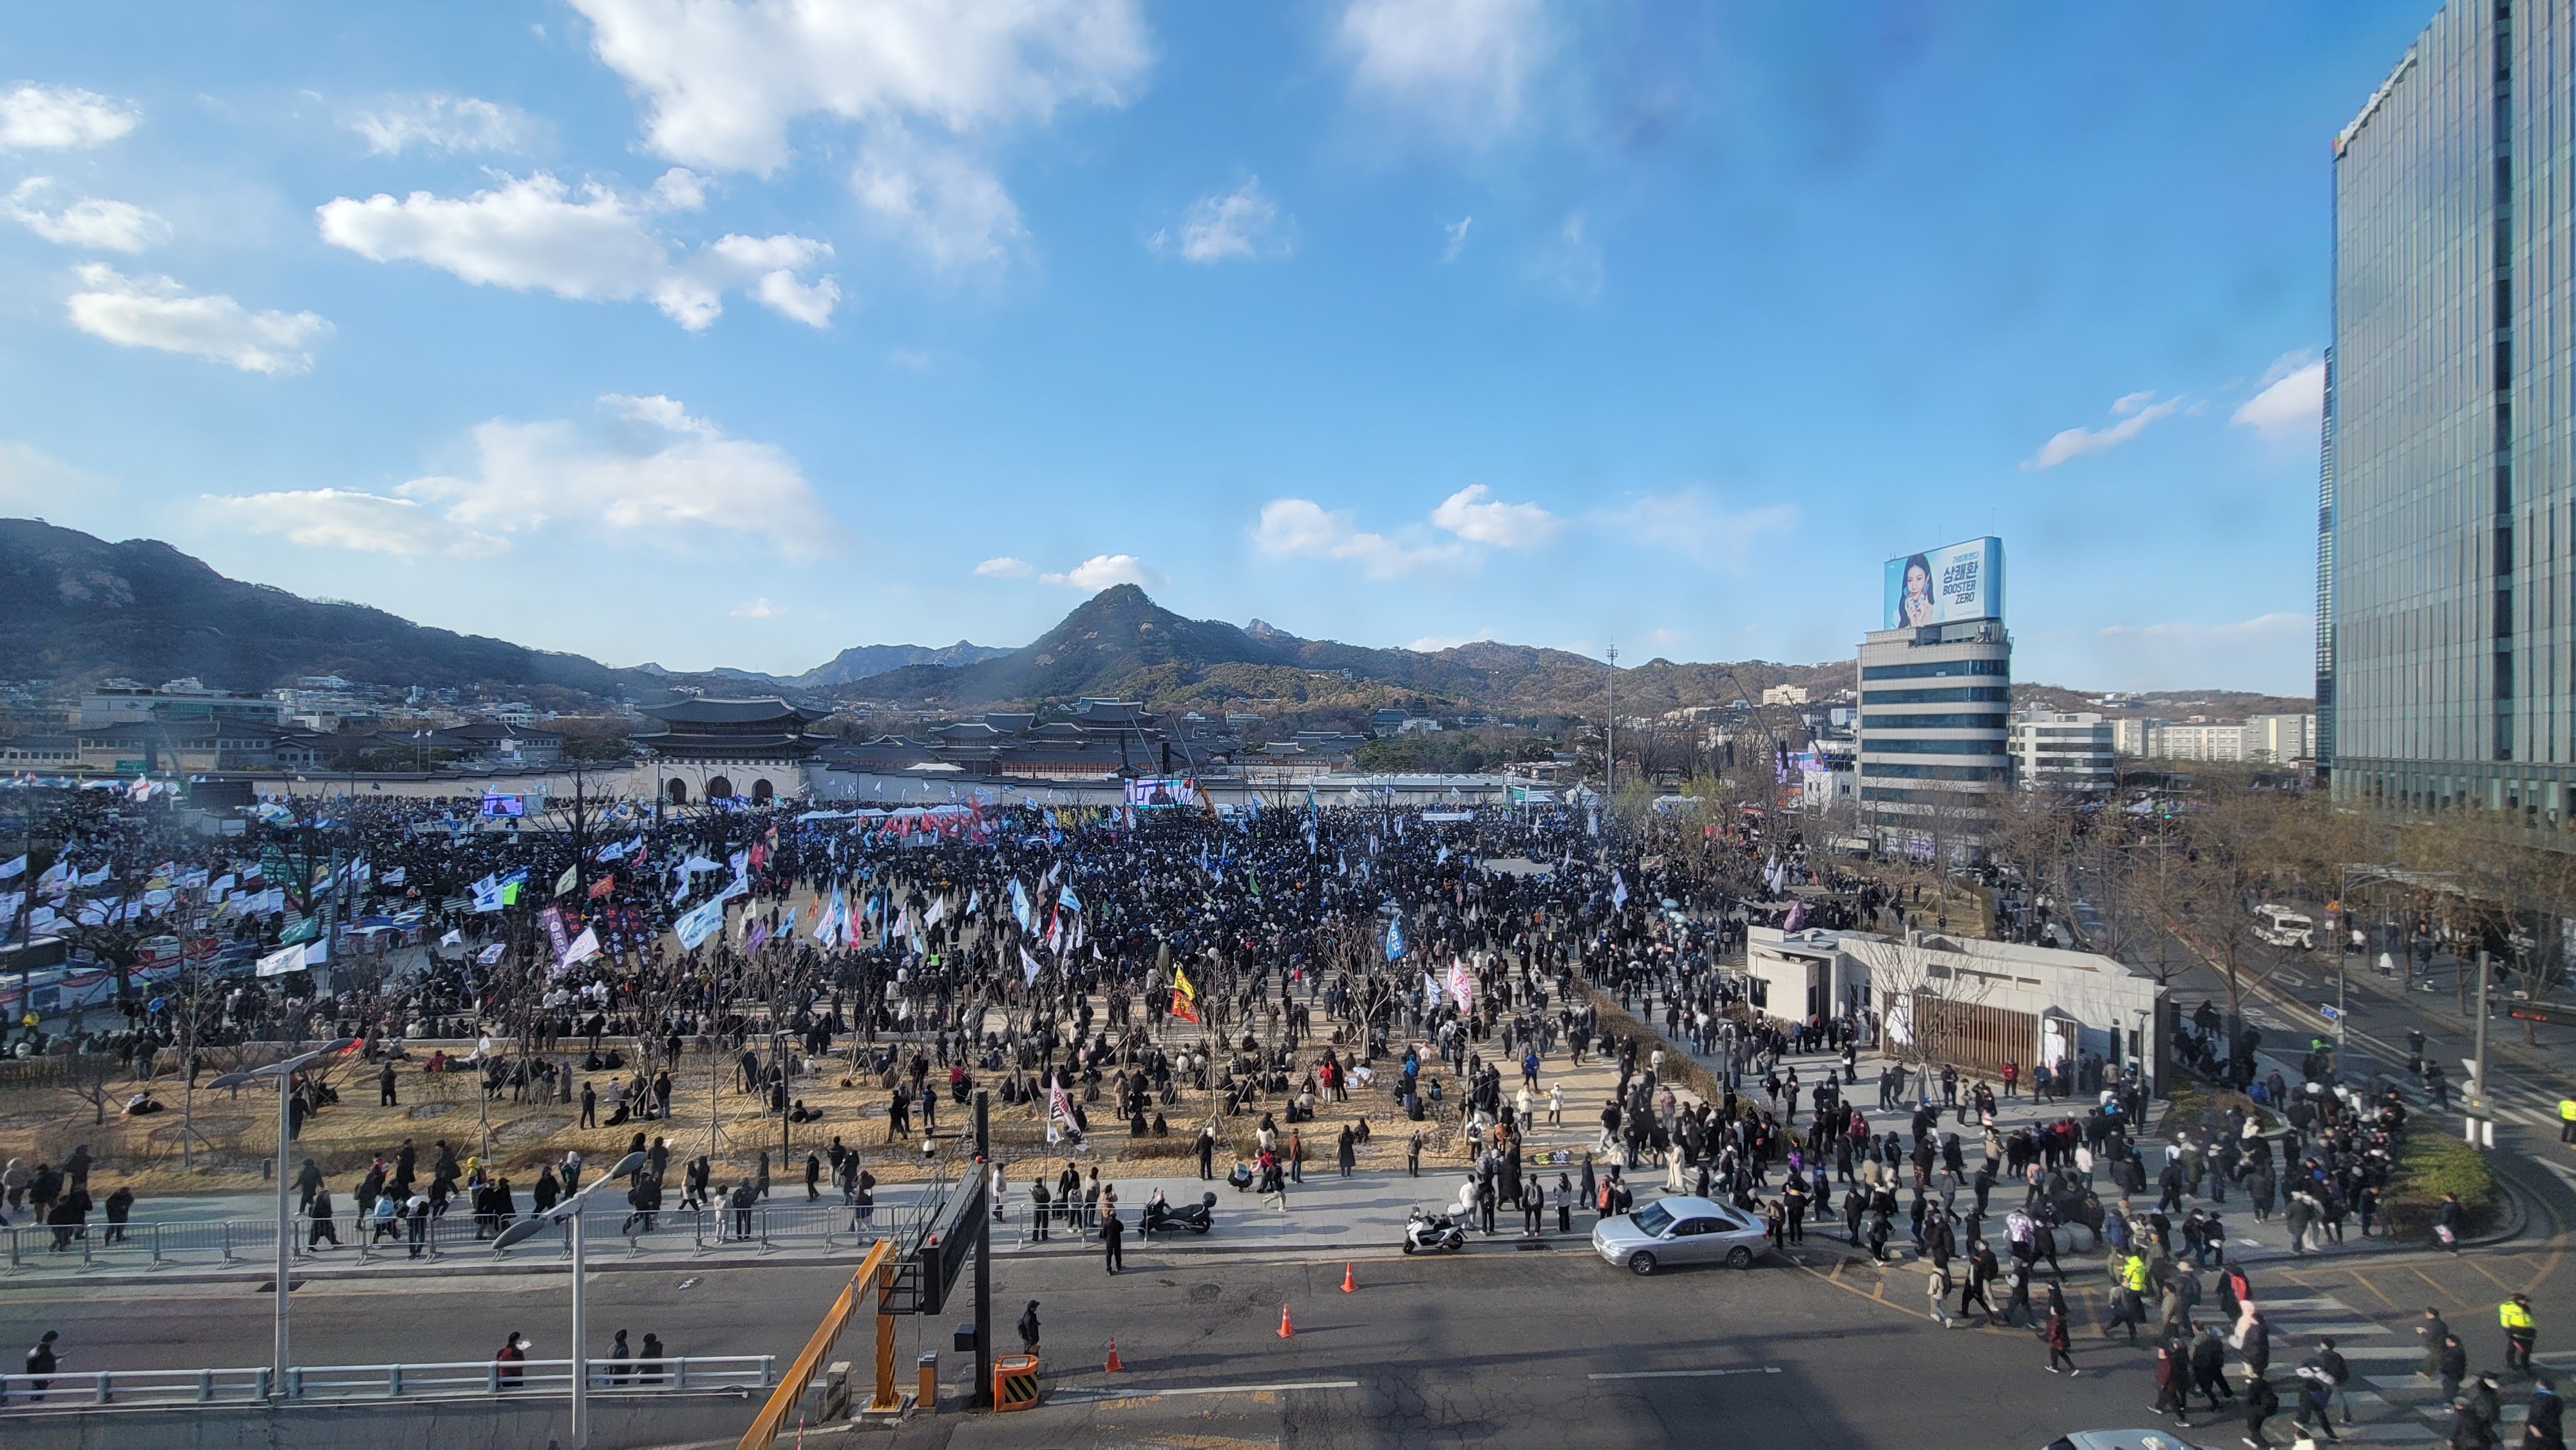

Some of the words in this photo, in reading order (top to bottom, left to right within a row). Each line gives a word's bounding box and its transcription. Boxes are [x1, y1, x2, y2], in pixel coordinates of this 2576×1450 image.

[1944, 561, 1978, 583] 상쾌환
[1944, 580, 1976, 595] BOOSTER
[1956, 592, 1975, 604] ZERO
